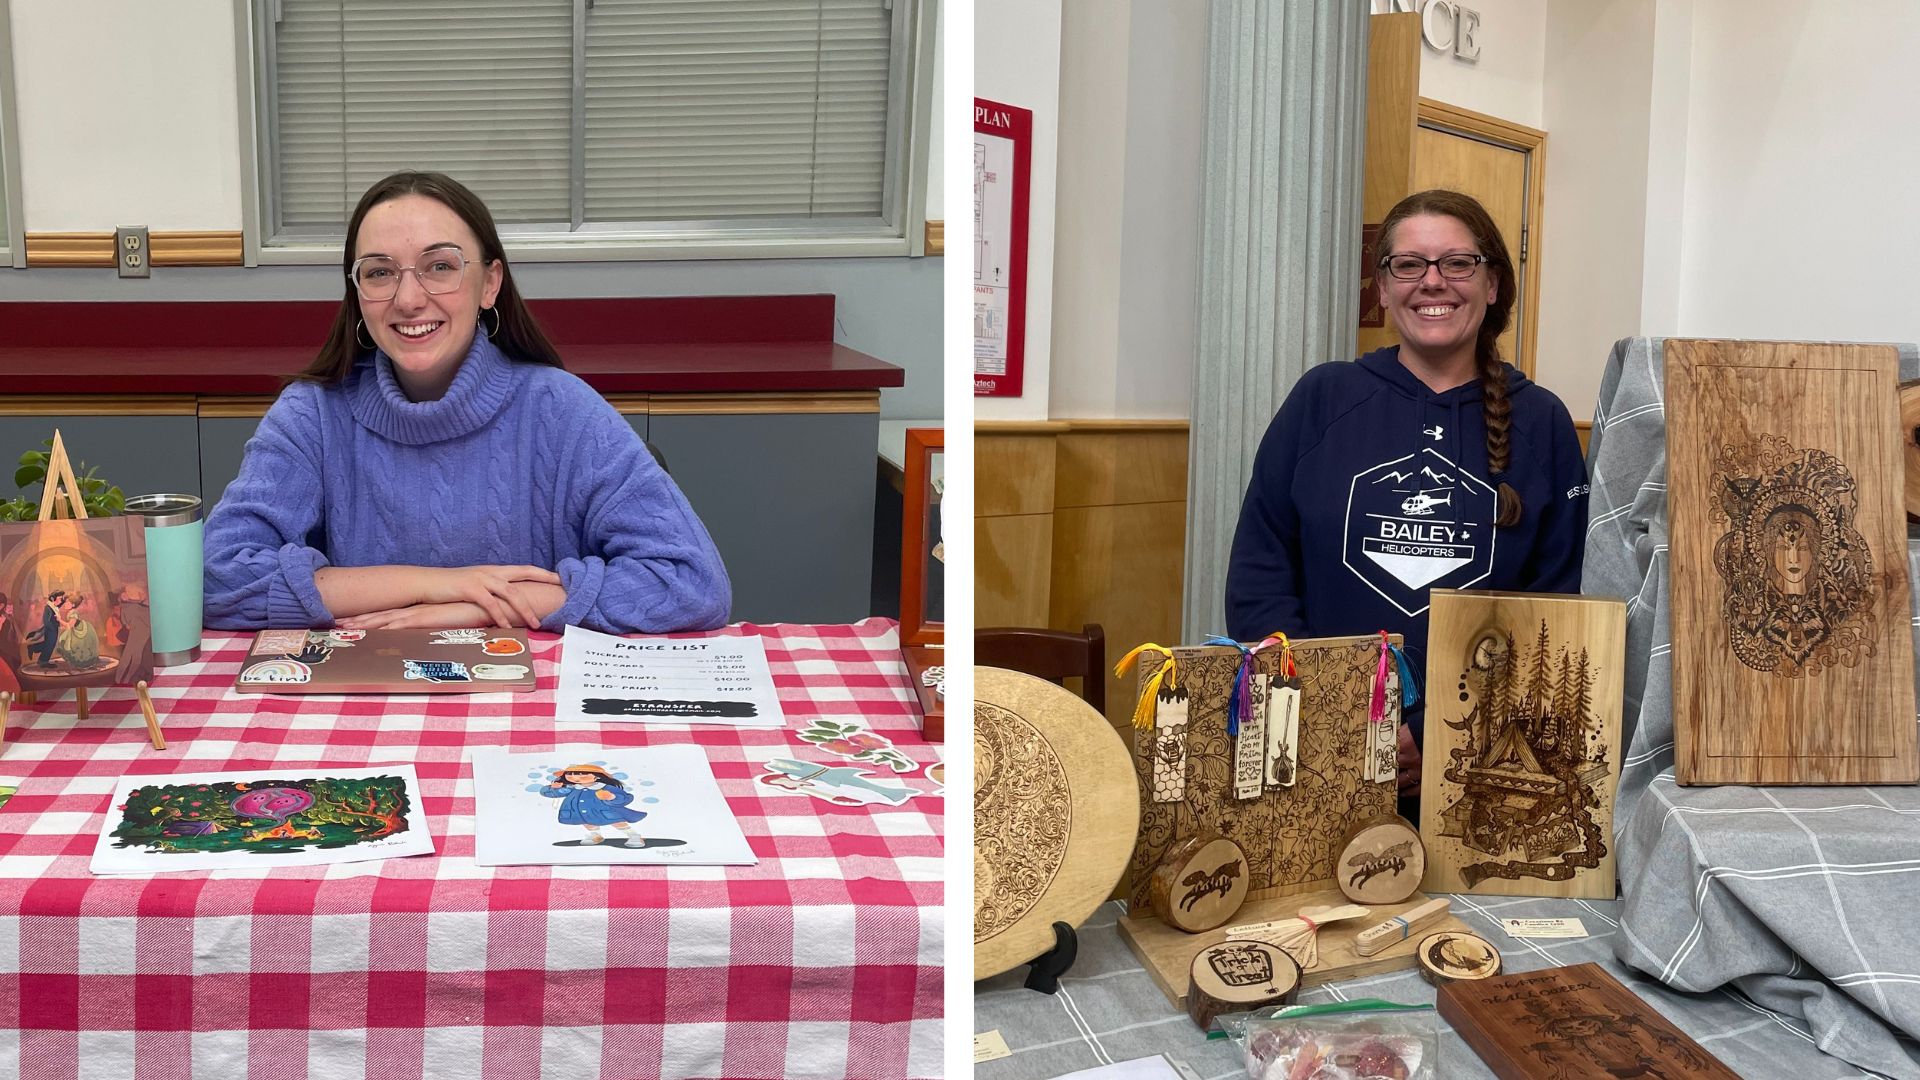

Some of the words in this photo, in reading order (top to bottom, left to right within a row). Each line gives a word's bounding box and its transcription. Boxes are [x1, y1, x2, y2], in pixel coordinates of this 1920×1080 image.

[975, 106, 1011, 129] PLAN
[1380, 520, 1456, 543] BAILEY
[1381, 543, 1456, 557] HELICOPTERS
[615, 642, 665, 651] PRICE
[584, 650, 631, 659] STICKERS
[243, 674, 262, 682] be
[269, 674, 308, 682] kind
[632, 702, 703, 710] ETRANSFER
[1214, 951, 1262, 968] Trick
[1222, 966, 1270, 983] Treat
